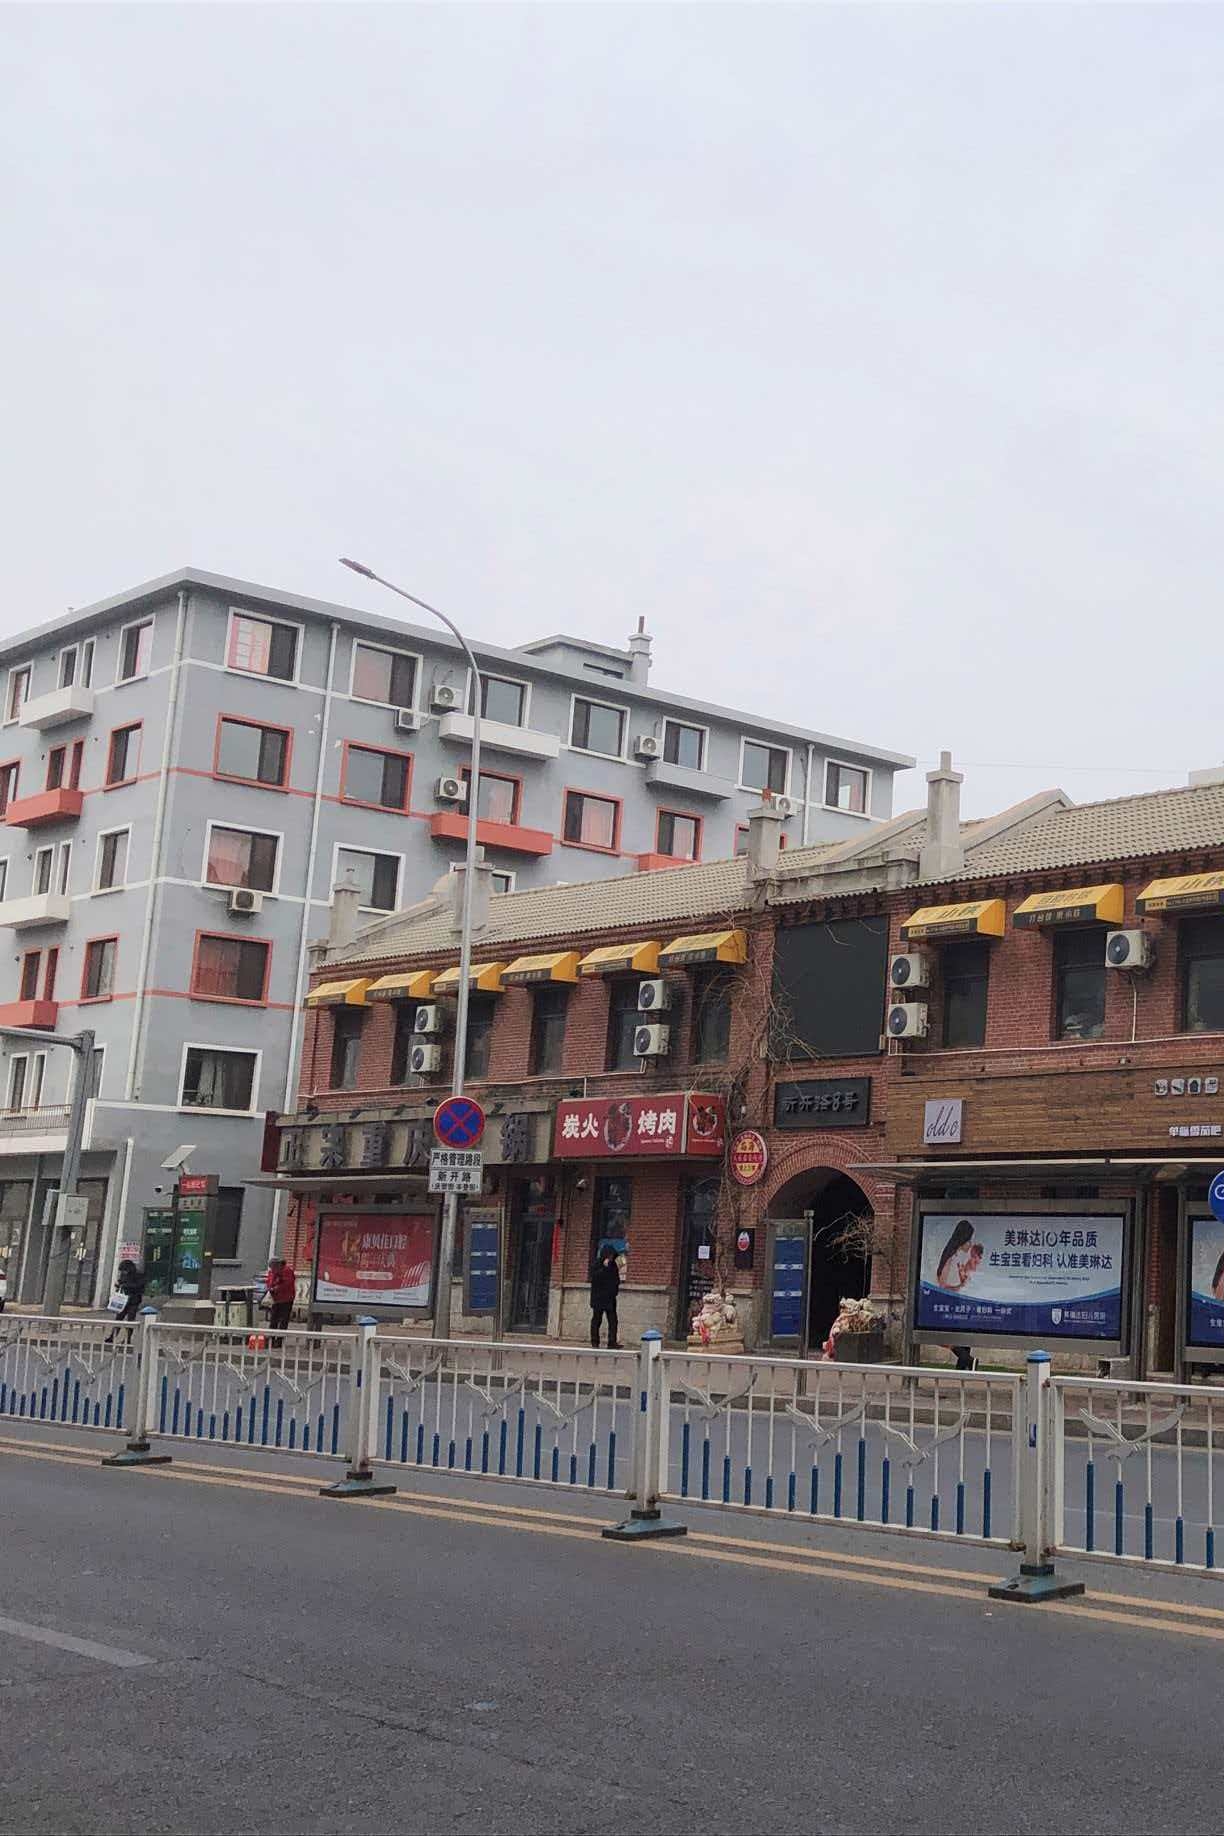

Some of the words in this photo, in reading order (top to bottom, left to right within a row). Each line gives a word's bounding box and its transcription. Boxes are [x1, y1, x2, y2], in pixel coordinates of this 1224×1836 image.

[562, 1113, 600, 1139] 炭火
[637, 1108, 677, 1136] 烤肉
[431, 1152, 481, 1167] 严格管理路段
[437, 1171, 472, 1182] 新开路
[1004, 1230, 1098, 1248] 美琳达10年品质
[989, 1252, 1053, 1268] 生宝宝看妇科
[1056, 1253, 1113, 1270] 认准美琳达
